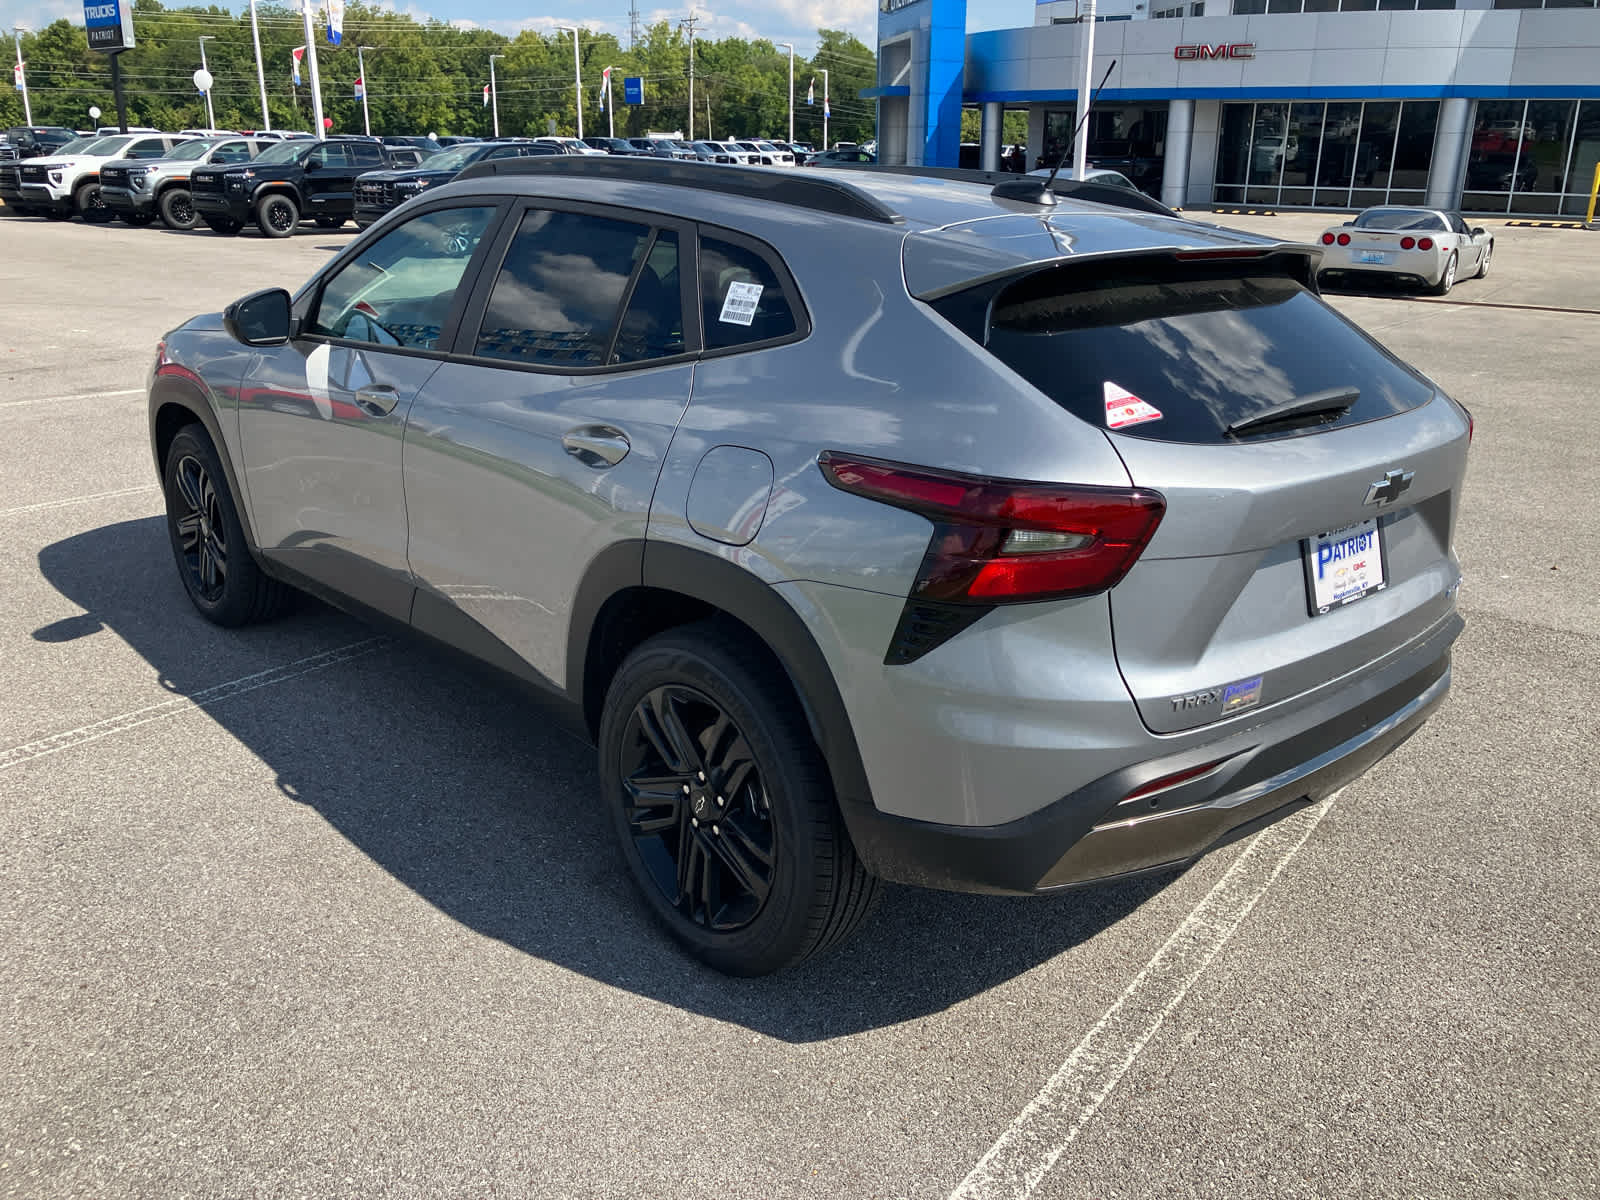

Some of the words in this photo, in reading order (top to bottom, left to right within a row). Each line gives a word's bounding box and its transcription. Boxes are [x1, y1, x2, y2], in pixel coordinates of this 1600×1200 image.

[84, 4, 116, 19] TRUCKS
[91, 30, 114, 41] PATRIOT
[1174, 42, 1257, 60] GMC
[1318, 530, 1374, 579] PATRIOT
[1170, 689, 1221, 712] TRAX
